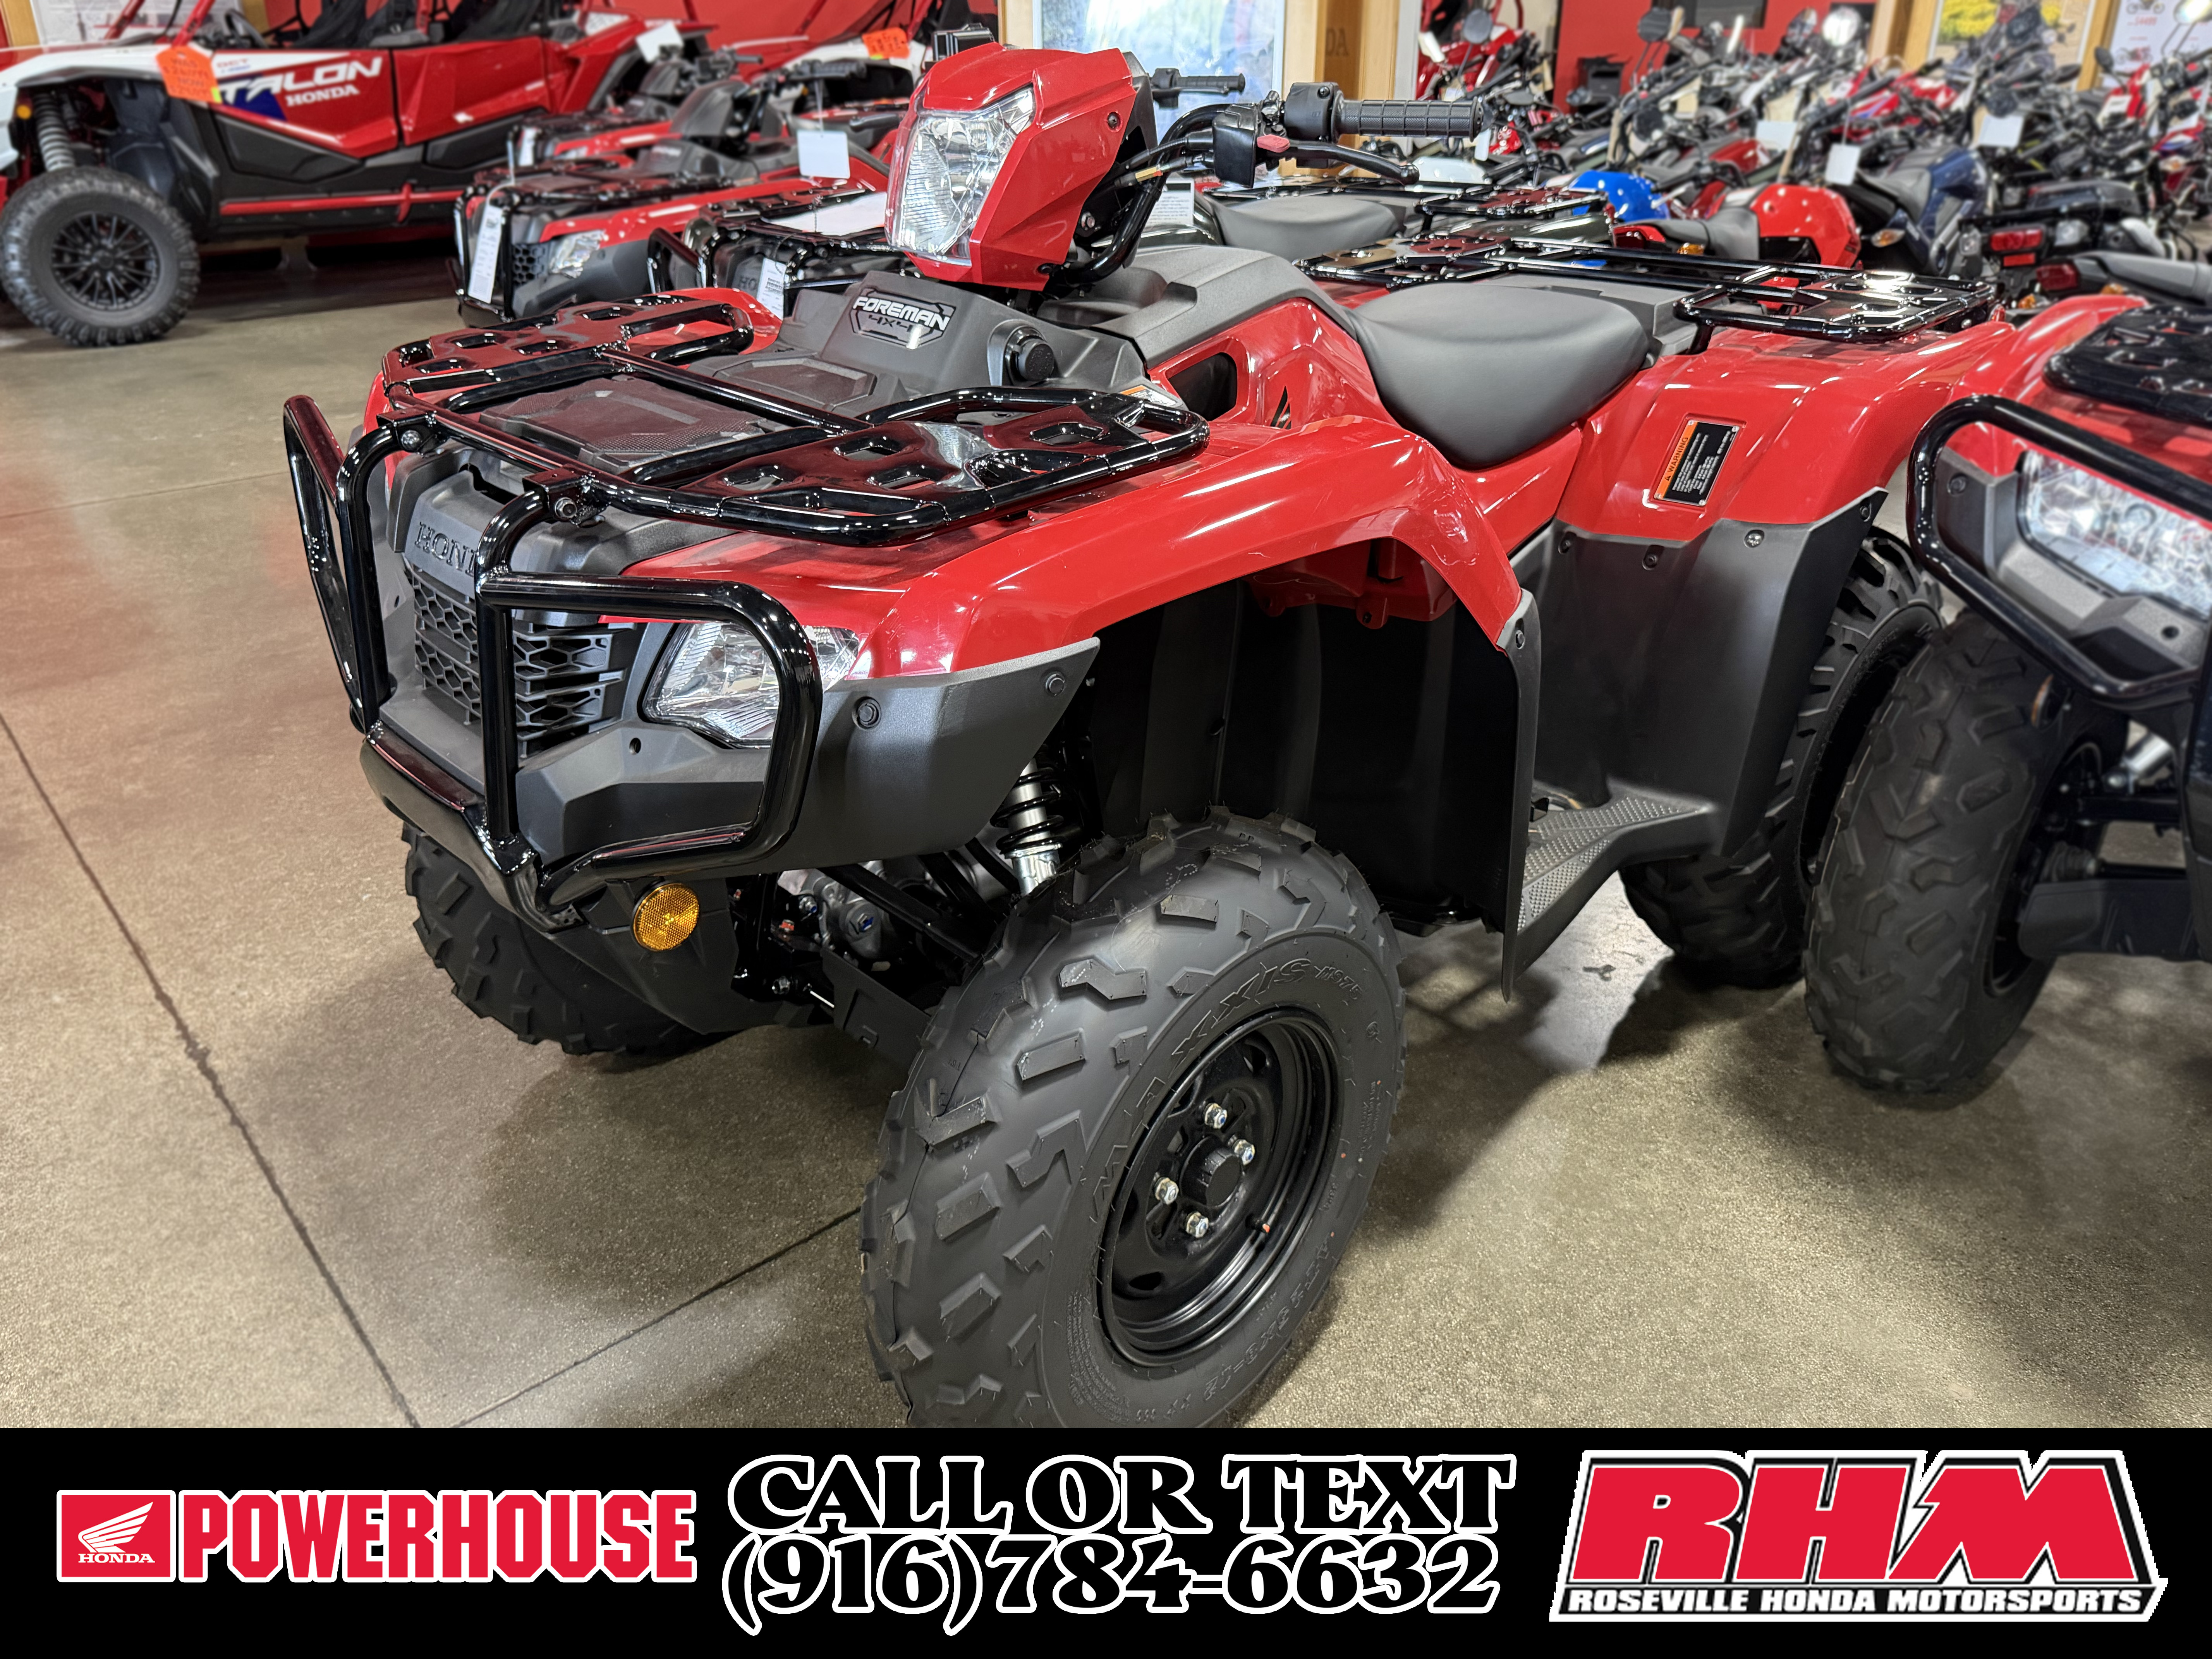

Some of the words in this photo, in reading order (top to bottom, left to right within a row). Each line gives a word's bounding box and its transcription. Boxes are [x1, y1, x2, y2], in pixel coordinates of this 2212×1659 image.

[219, 57, 382, 105] TALON
[285, 84, 360, 107] HONDA
[853, 296, 950, 331] FOREMAN
[1668, 437, 1688, 472] WARNING
[414, 522, 477, 577] HON
[1093, 958, 1314, 1212] MAXXIS
